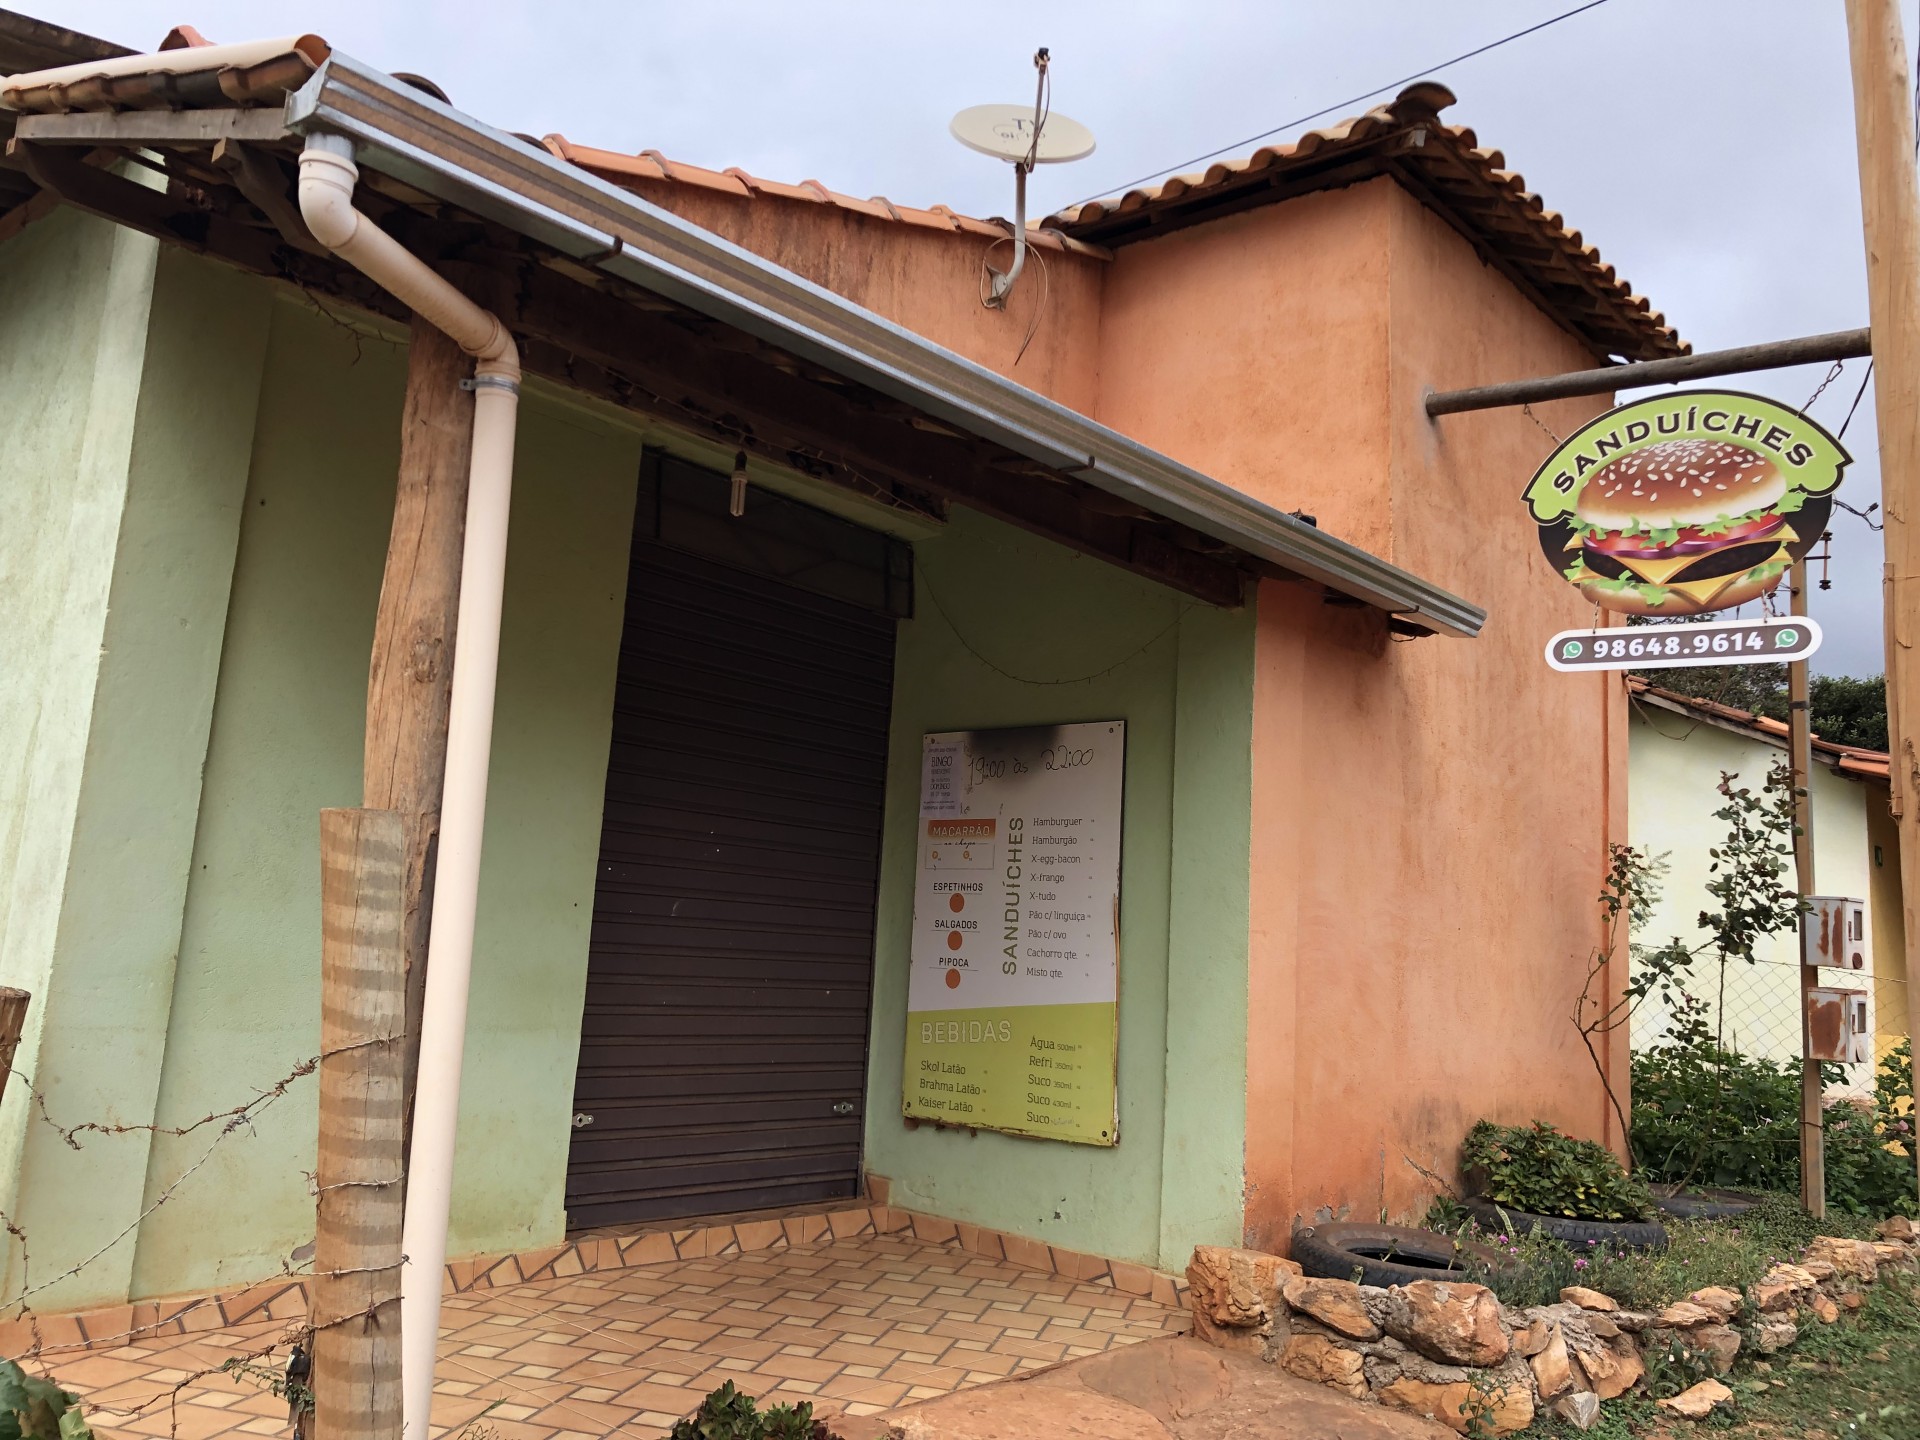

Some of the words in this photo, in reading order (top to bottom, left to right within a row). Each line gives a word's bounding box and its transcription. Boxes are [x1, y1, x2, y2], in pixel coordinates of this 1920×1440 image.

[1553, 406, 1814, 494] SANDUÍCHES
[1593, 631, 1764, 658] 98648.9614
[931, 756, 953, 767] BINGO
[968, 757, 1005, 785] 19:00
[1040, 745, 1094, 771] 22:00
[1033, 817, 1083, 828] Hamburguer
[933, 823, 990, 836] MACARRÃO
[1032, 836, 1078, 847] Hamburgão
[1031, 854, 1081, 865] X-egg-bacon
[1030, 873, 1065, 884] X-frango
[933, 882, 984, 891] ESPETINHOS
[1002, 817, 1024, 976] SANDUÍCHES
[1029, 892, 1056, 901] X-tudo
[1028, 910, 1043, 919] Pão
[1053, 910, 1086, 922] linguiça
[934, 919, 978, 929] SALGADOS
[1027, 929, 1042, 938] Pão
[1053, 931, 1067, 939] ovo
[1026, 948, 1062, 958] Cachorro
[938, 957, 969, 967] PIPOCA
[1026, 966, 1048, 977] Misto
[921, 1020, 1011, 1044] BEBIDAS
[920, 1060, 940, 1072] Skol
[941, 1062, 966, 1075] Latão
[1028, 1055, 1053, 1069] Refri
[919, 1078, 954, 1092] Brahma
[956, 1082, 981, 1095] Latão
[1027, 1074, 1051, 1087] Suco
[918, 1095, 946, 1109] Kaiser
[948, 1099, 973, 1113] Latão
[1026, 1092, 1051, 1106] Suco
[1026, 1111, 1050, 1125] Suco
